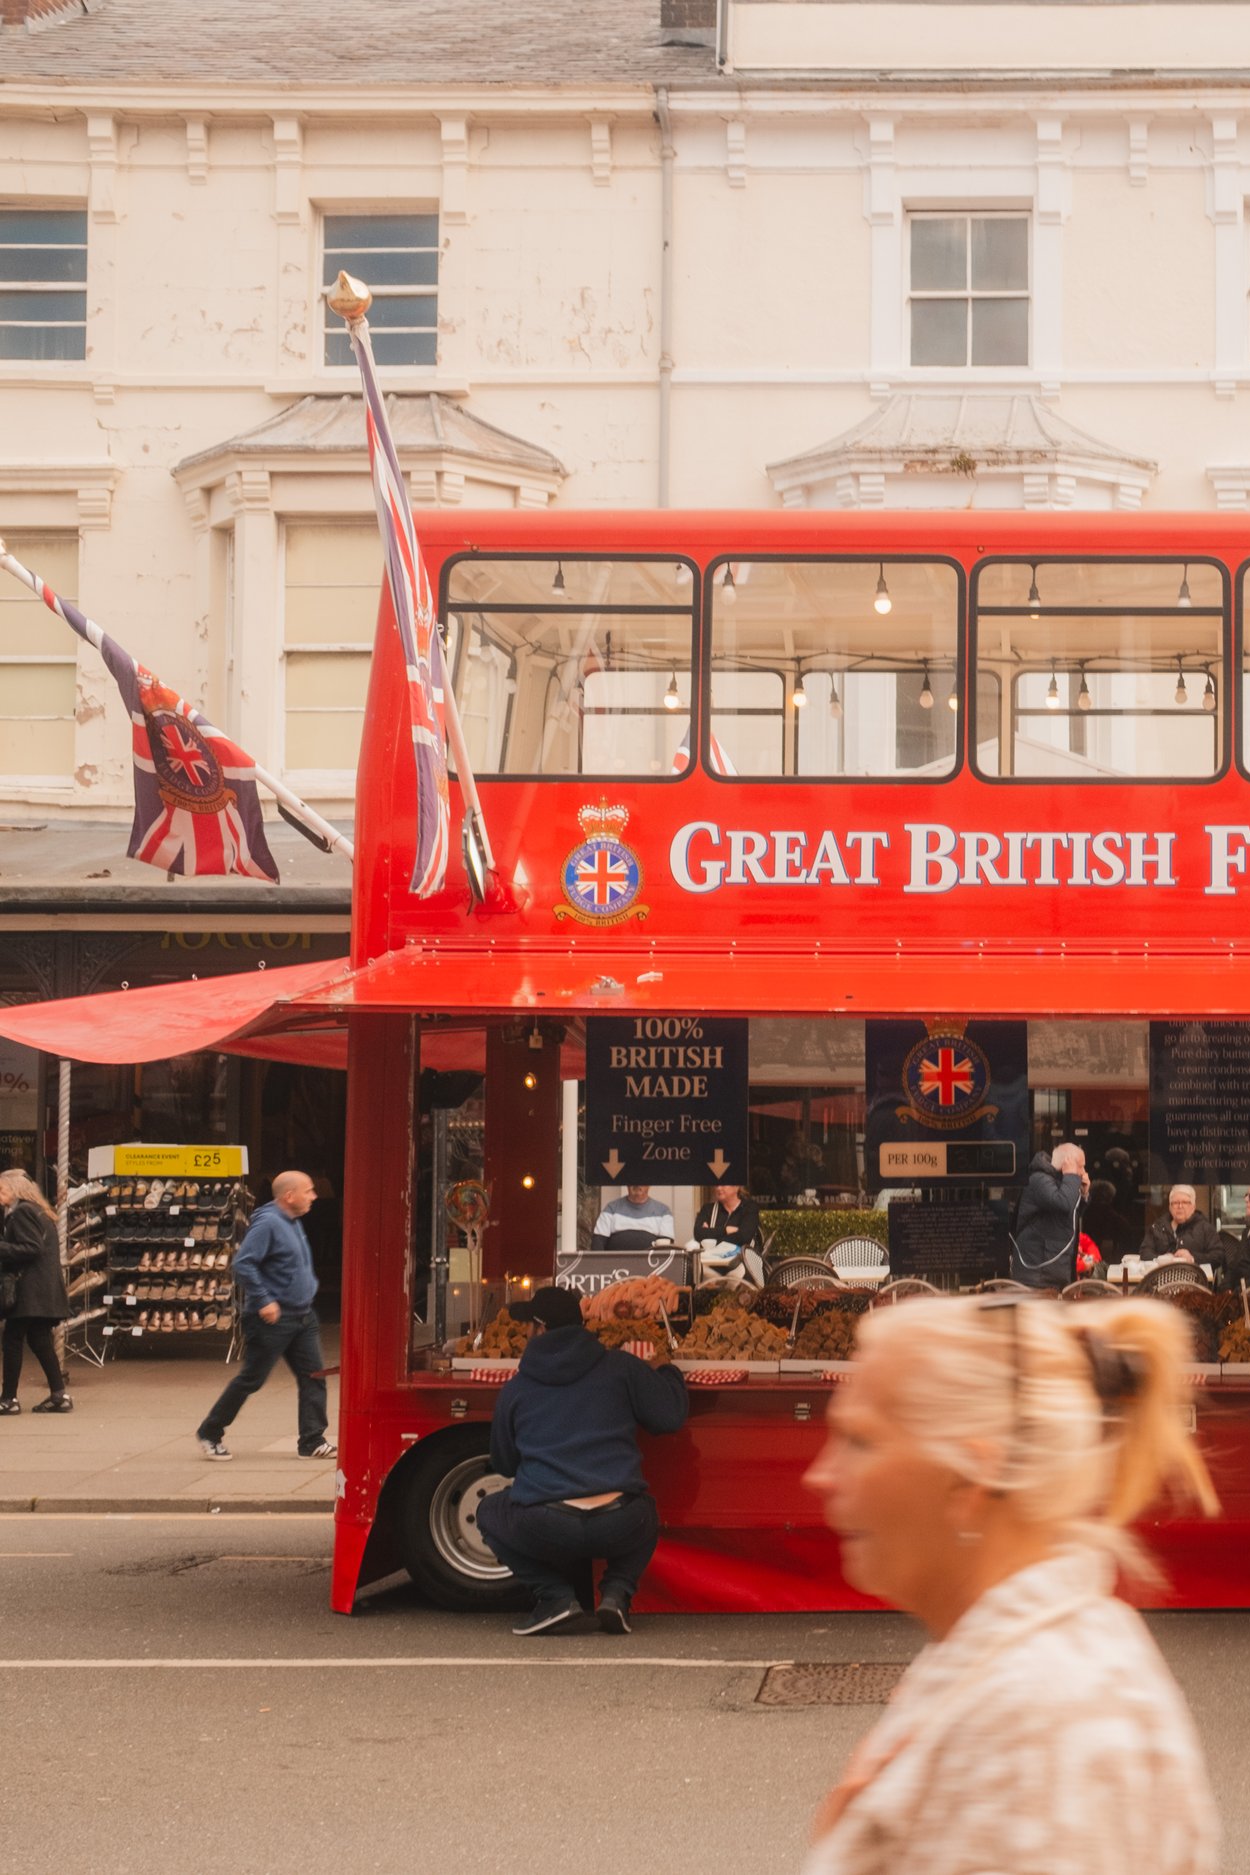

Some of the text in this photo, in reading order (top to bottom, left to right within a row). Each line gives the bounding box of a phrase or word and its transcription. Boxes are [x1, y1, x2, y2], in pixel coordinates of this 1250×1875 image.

[570, 843, 634, 866] GREAT BRITISH
[669, 821, 889, 893] GREAT
[903, 823, 1177, 893] BRITISH
[567, 885, 636, 912] FUDGE COMPANY
[633, 1018, 704, 1039] 100%
[1164, 1035, 1177, 1045] go
[1179, 1033, 1188, 1043] in
[1202, 1033, 1241, 1045] creating
[609, 1046, 724, 1068] BRITISH
[1171, 1048, 1195, 1059] Pure
[1196, 1048, 1219, 1061] dairy
[1223, 1048, 1250, 1059] butter
[1177, 1066, 1207, 1074] cream
[625, 1075, 708, 1097] MADE
[1169, 1079, 1216, 1090] combined
[1218, 1079, 1240, 1090] with
[1168, 1094, 1238, 1107] manufacturing
[1165, 1112, 1218, 1123] guarantees
[1220, 1110, 1231, 1121] all
[1234, 1113, 1249, 1121] our
[612, 1114, 722, 1138] Finger Free
[1167, 1126, 1190, 1137] have
[1199, 1126, 1248, 1137] distinctive
[642, 1142, 691, 1160] Zone
[1168, 1144, 1185, 1152] are
[1186, 1141, 1216, 1155] highly
[194, 1153, 221, 1167] £25
[888, 1153, 938, 1166] PER 100g
[1184, 1157, 1249, 1170] confectionery
